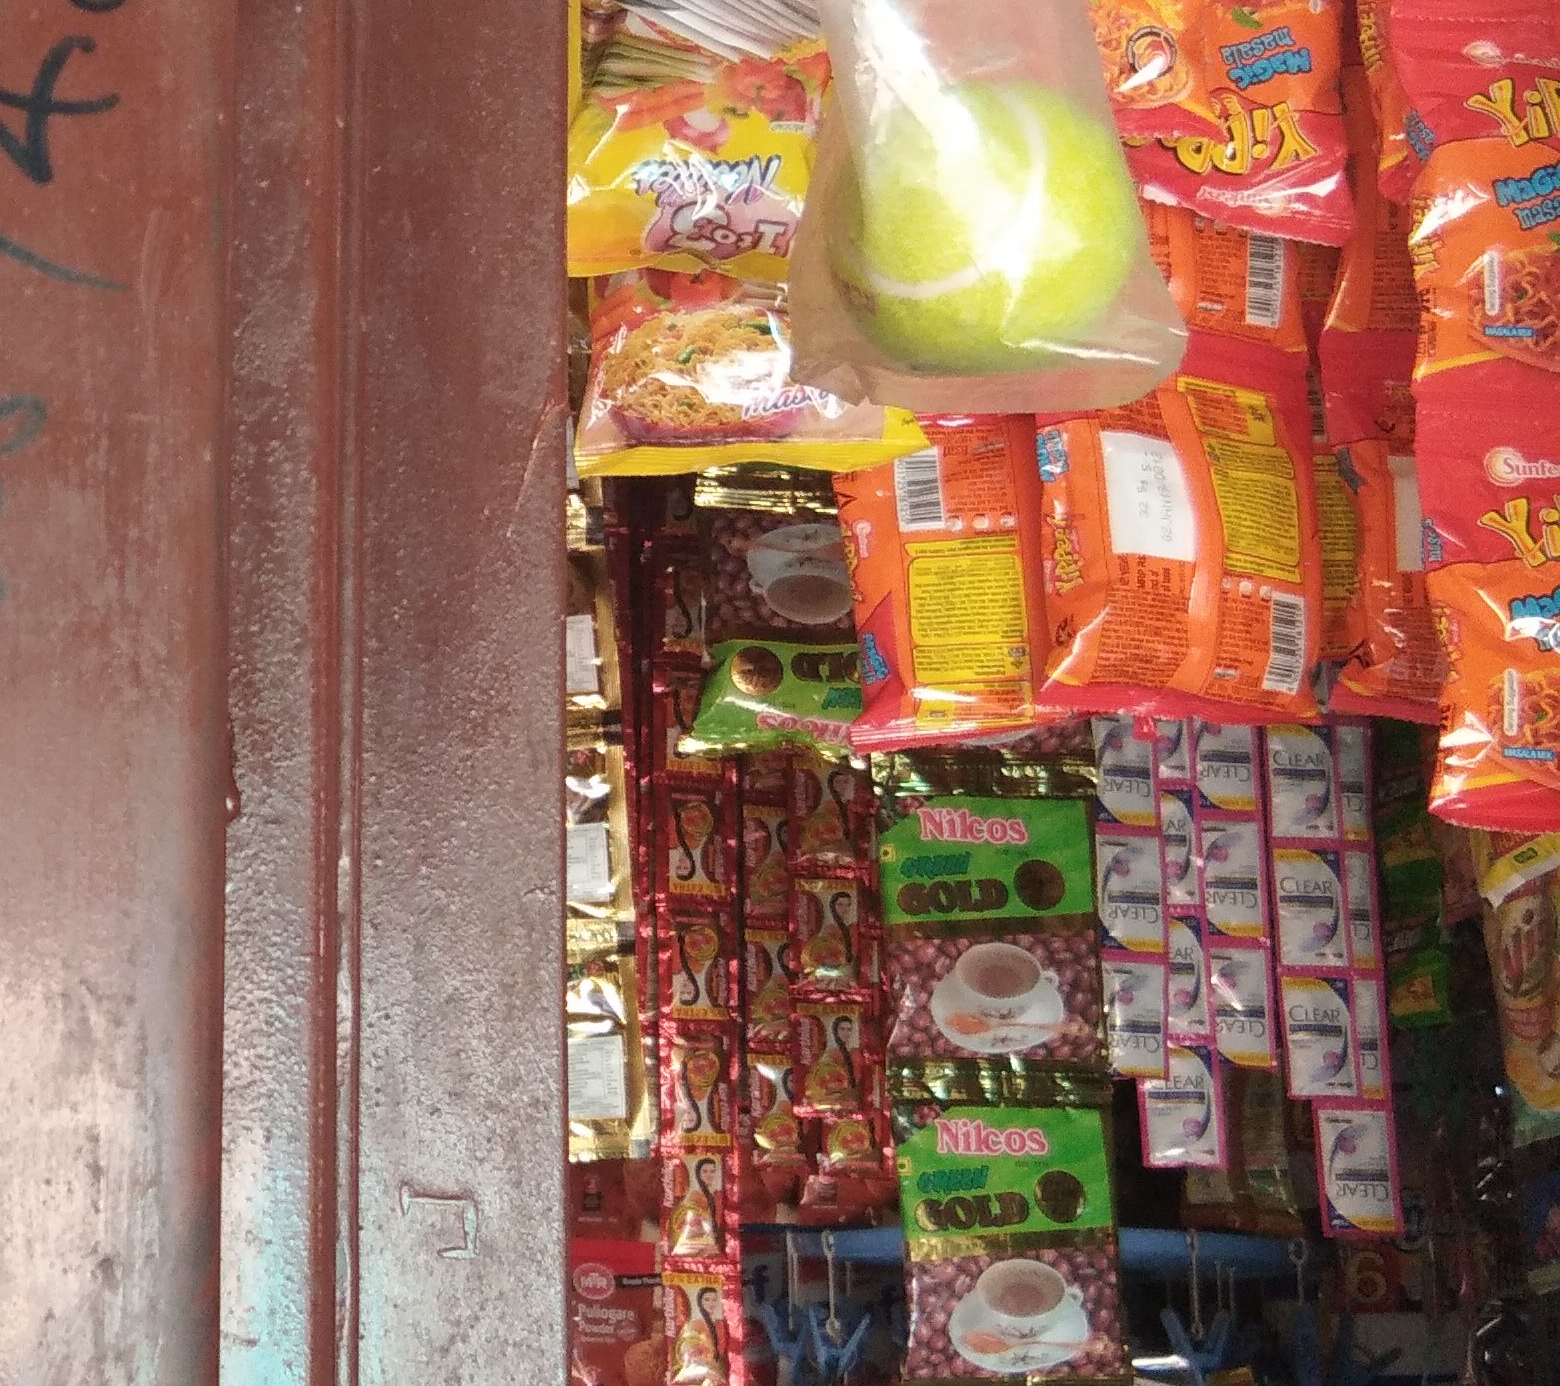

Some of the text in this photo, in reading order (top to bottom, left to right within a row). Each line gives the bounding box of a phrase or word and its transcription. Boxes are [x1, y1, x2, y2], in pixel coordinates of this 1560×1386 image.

[1273, 751, 1327, 766] CLEAR
[1200, 765, 1251, 782] CLEAR
[1103, 778, 1150, 797] CLEAR
[1280, 877, 1333, 894] CLEAR
[897, 879, 1009, 915] GOLD
[1205, 891, 1259, 908] CLEAR
[1109, 907, 1160, 924] CLEAR
[1290, 1004, 1340, 1022] CLEAR
[1109, 1036, 1160, 1053] CLEAR
[935, 1118, 1049, 1156] Nilcos
[1335, 1184, 1388, 1202] CLEAR
[915, 1192, 1030, 1231] GOLD
